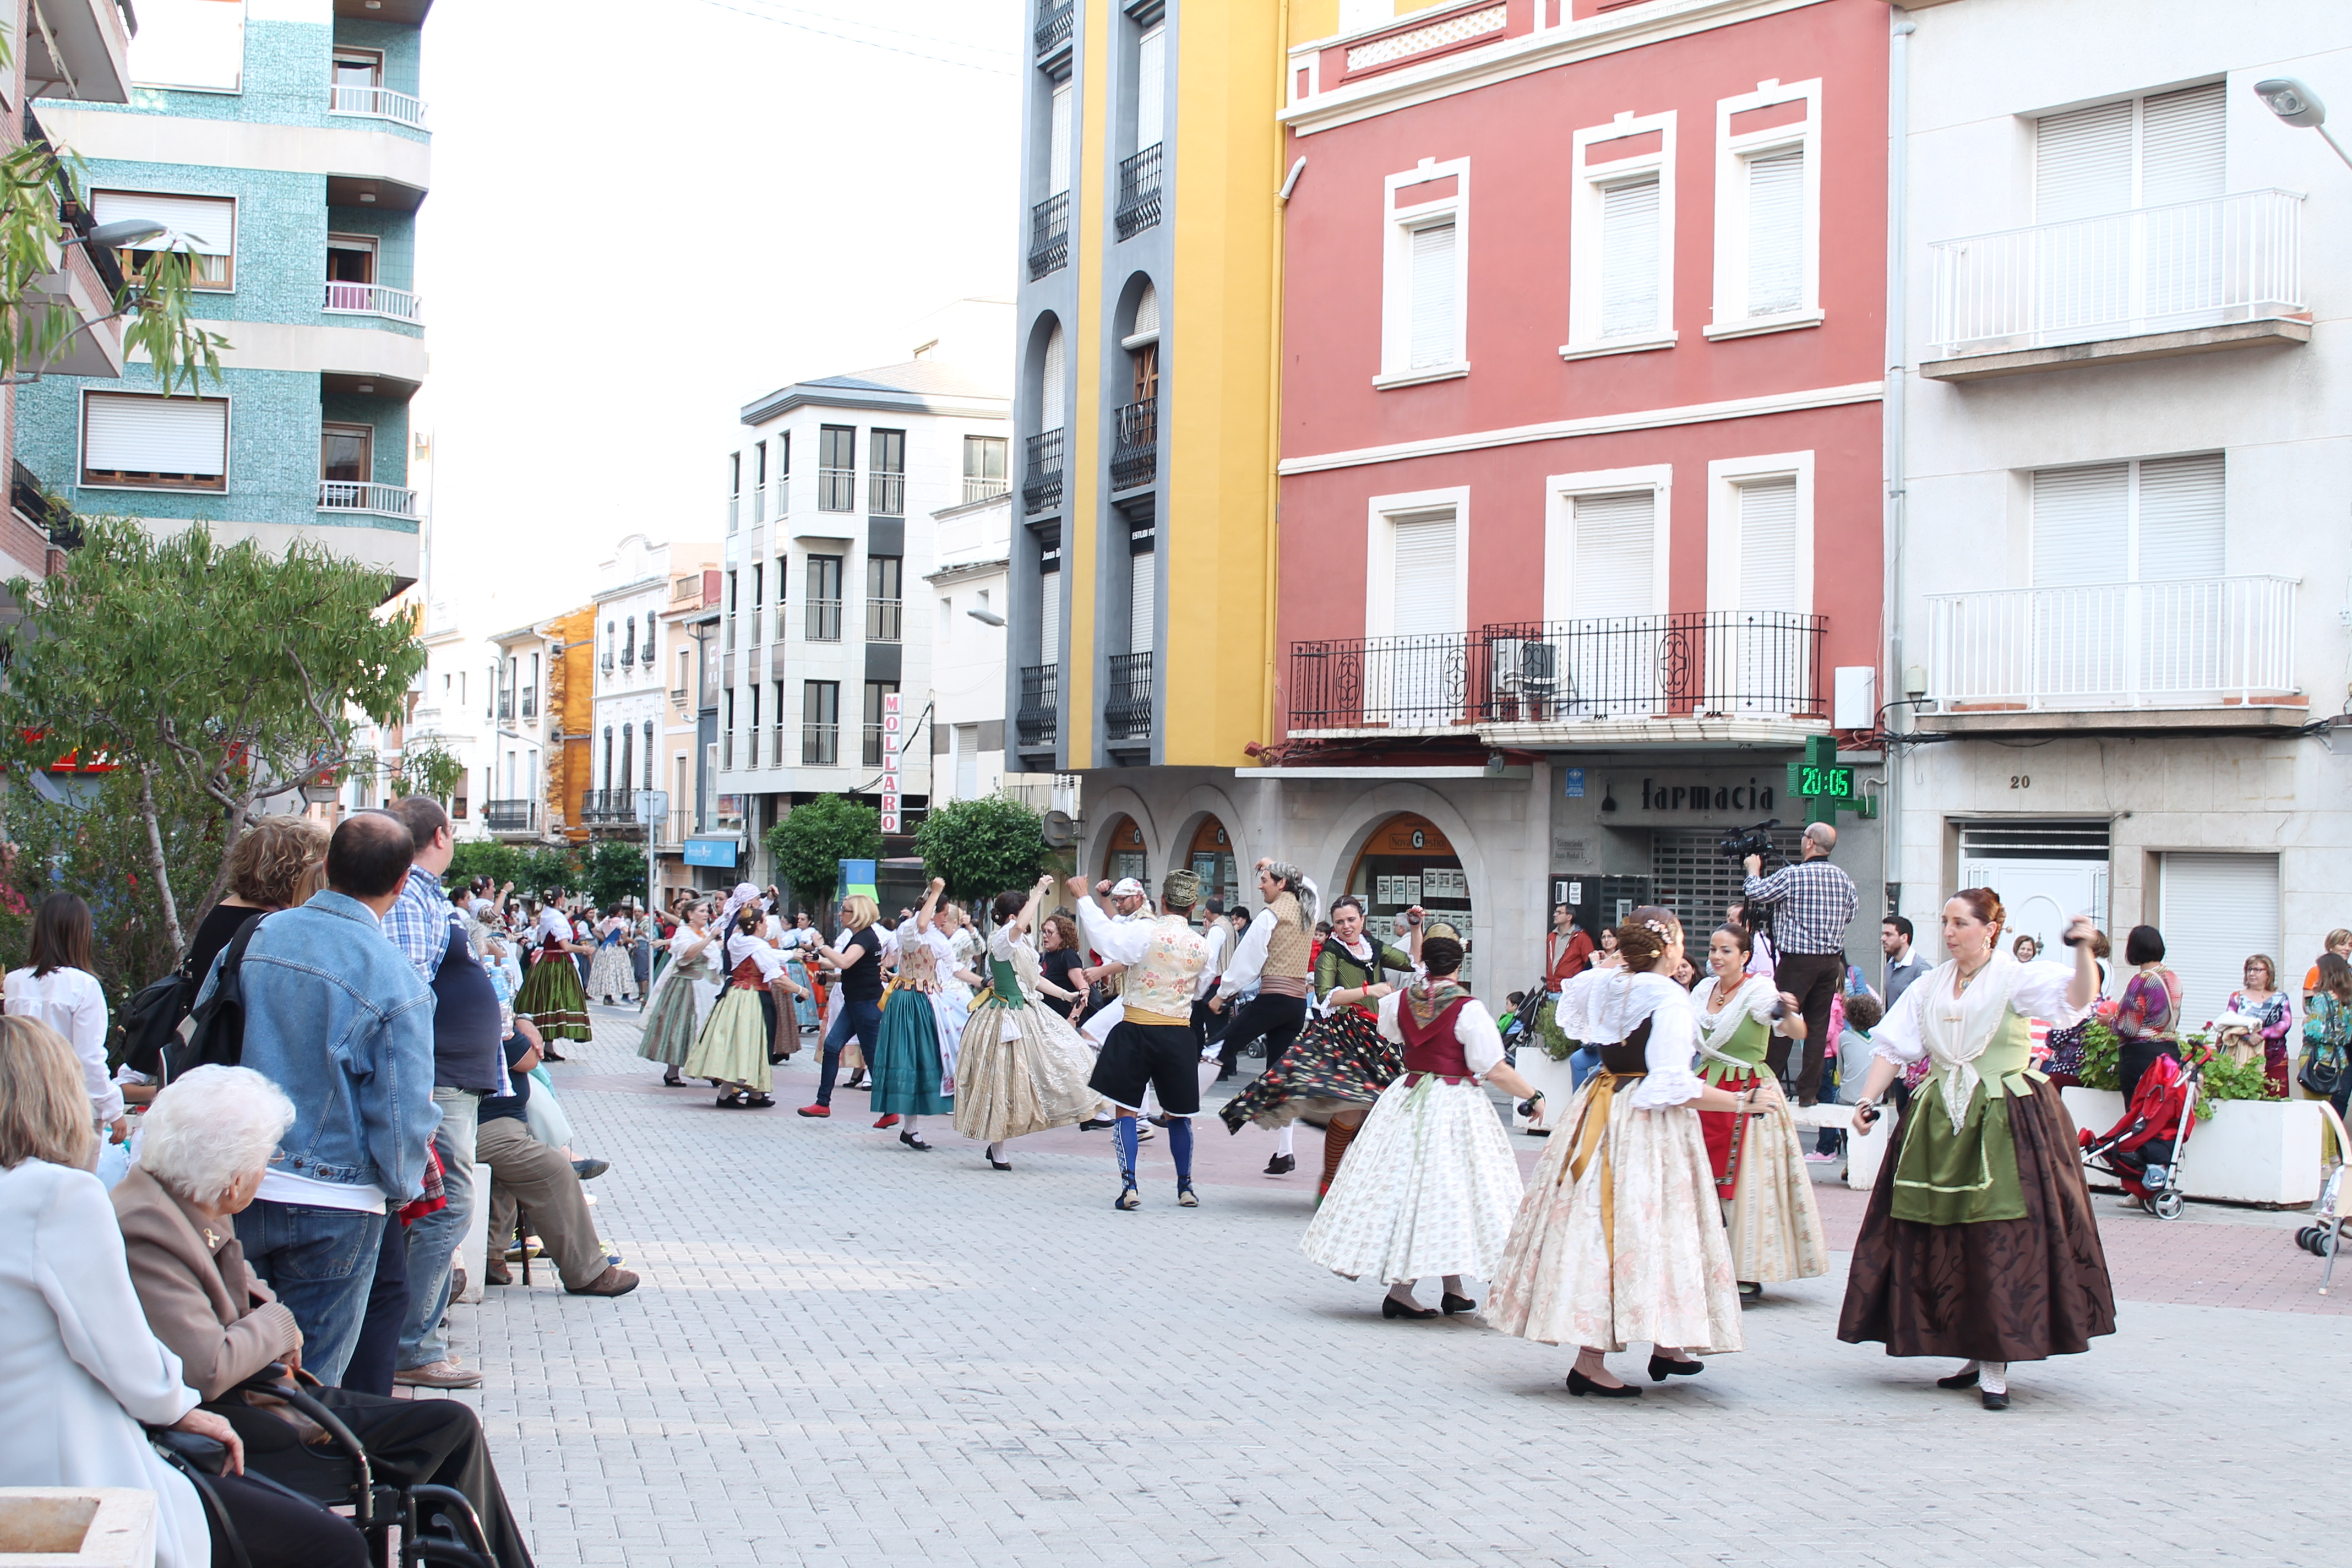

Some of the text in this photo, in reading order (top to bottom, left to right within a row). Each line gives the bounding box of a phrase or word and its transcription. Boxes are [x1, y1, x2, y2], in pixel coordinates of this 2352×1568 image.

[883, 696, 898, 830] MOLLARO
[1641, 777, 1774, 810] farmacia
[1802, 767, 1848, 796] 20:05
[2010, 775, 2030, 789] 20
